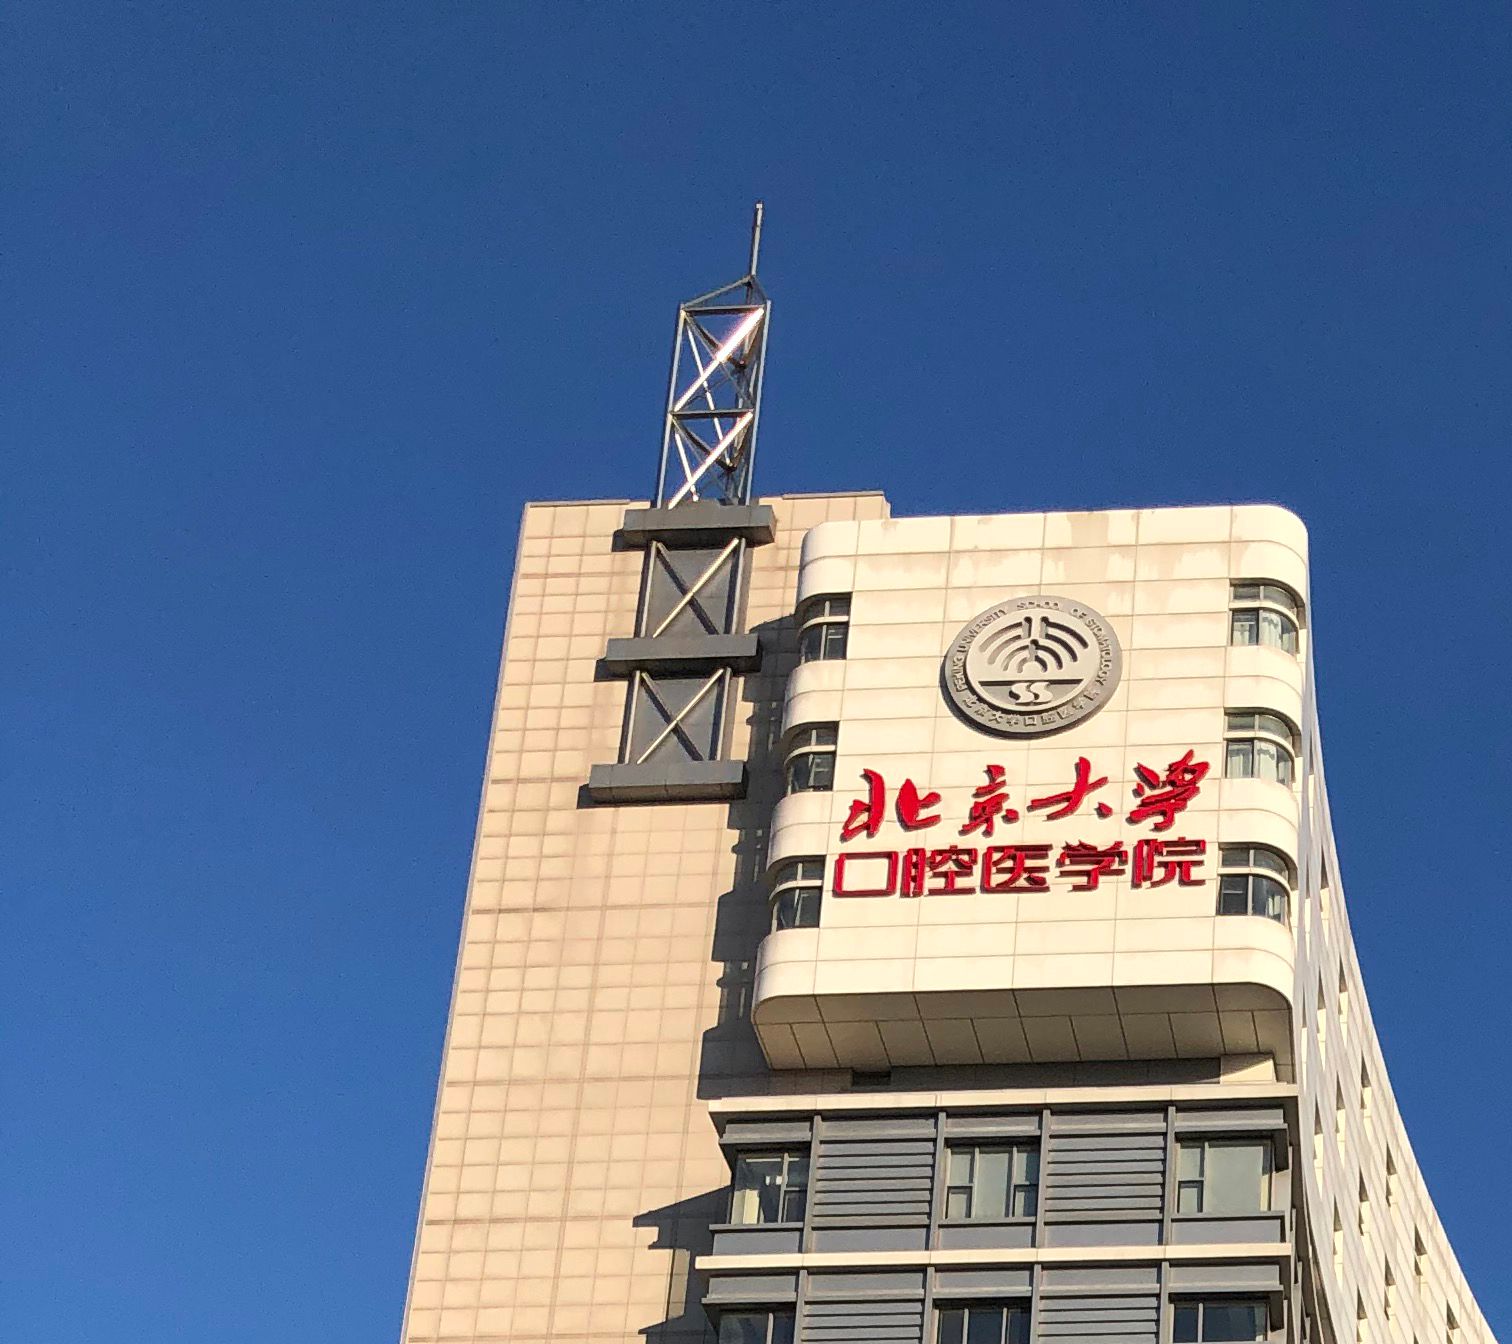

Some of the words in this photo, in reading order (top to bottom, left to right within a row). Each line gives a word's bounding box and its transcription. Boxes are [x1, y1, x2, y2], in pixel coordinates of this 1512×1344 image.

[957, 607, 1007, 653] UNIVERSITY
[840, 749, 1210, 843] 北京大学
[832, 837, 1208, 899] 口腔医学院
